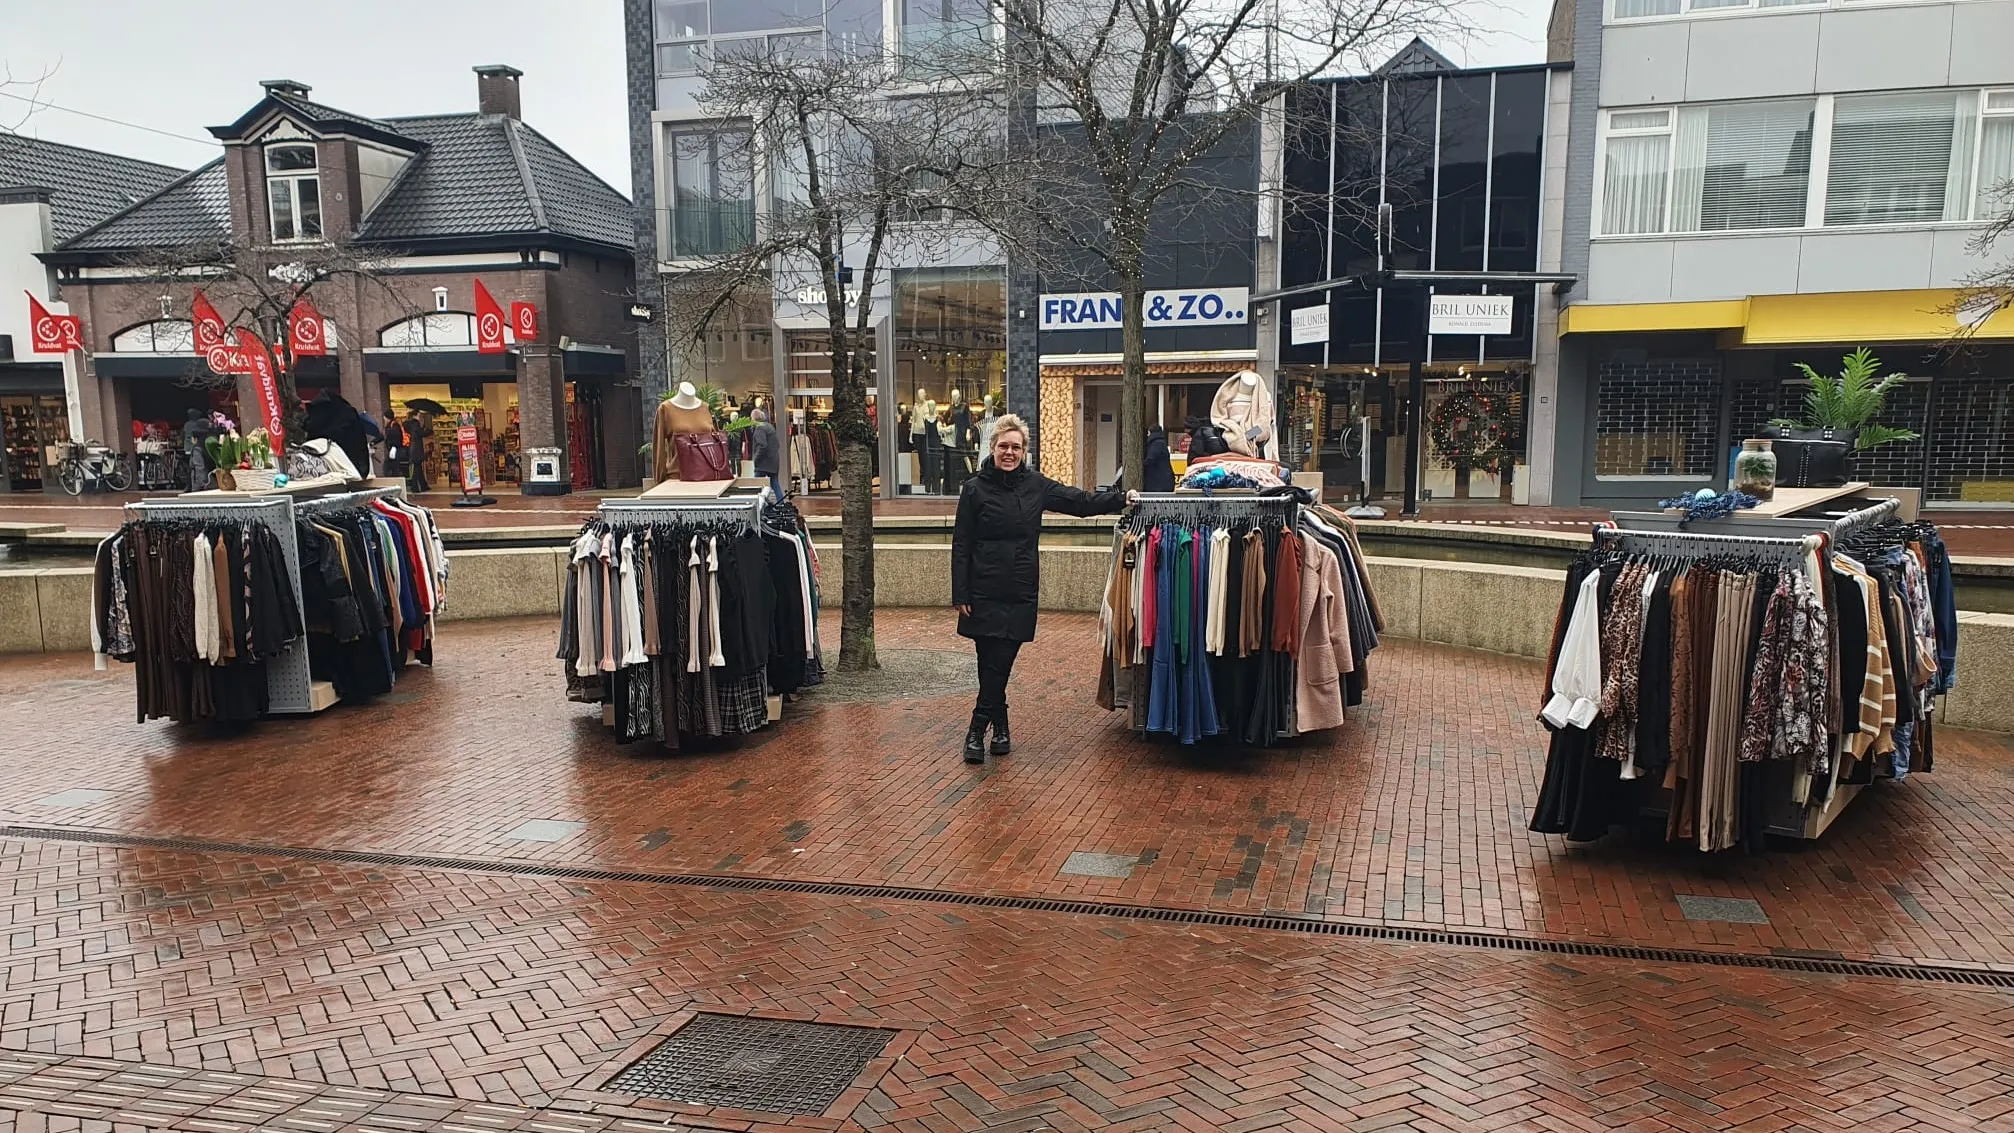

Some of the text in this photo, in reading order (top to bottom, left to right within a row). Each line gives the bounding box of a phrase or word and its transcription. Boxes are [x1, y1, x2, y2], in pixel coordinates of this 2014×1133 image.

[1045, 294, 1244, 323] FRAN & ZO..
[1432, 303, 1509, 316] BRIL UNIEK
[1307, 312, 1328, 326] UNIEK
[1472, 381, 1517, 392] UNIEK
